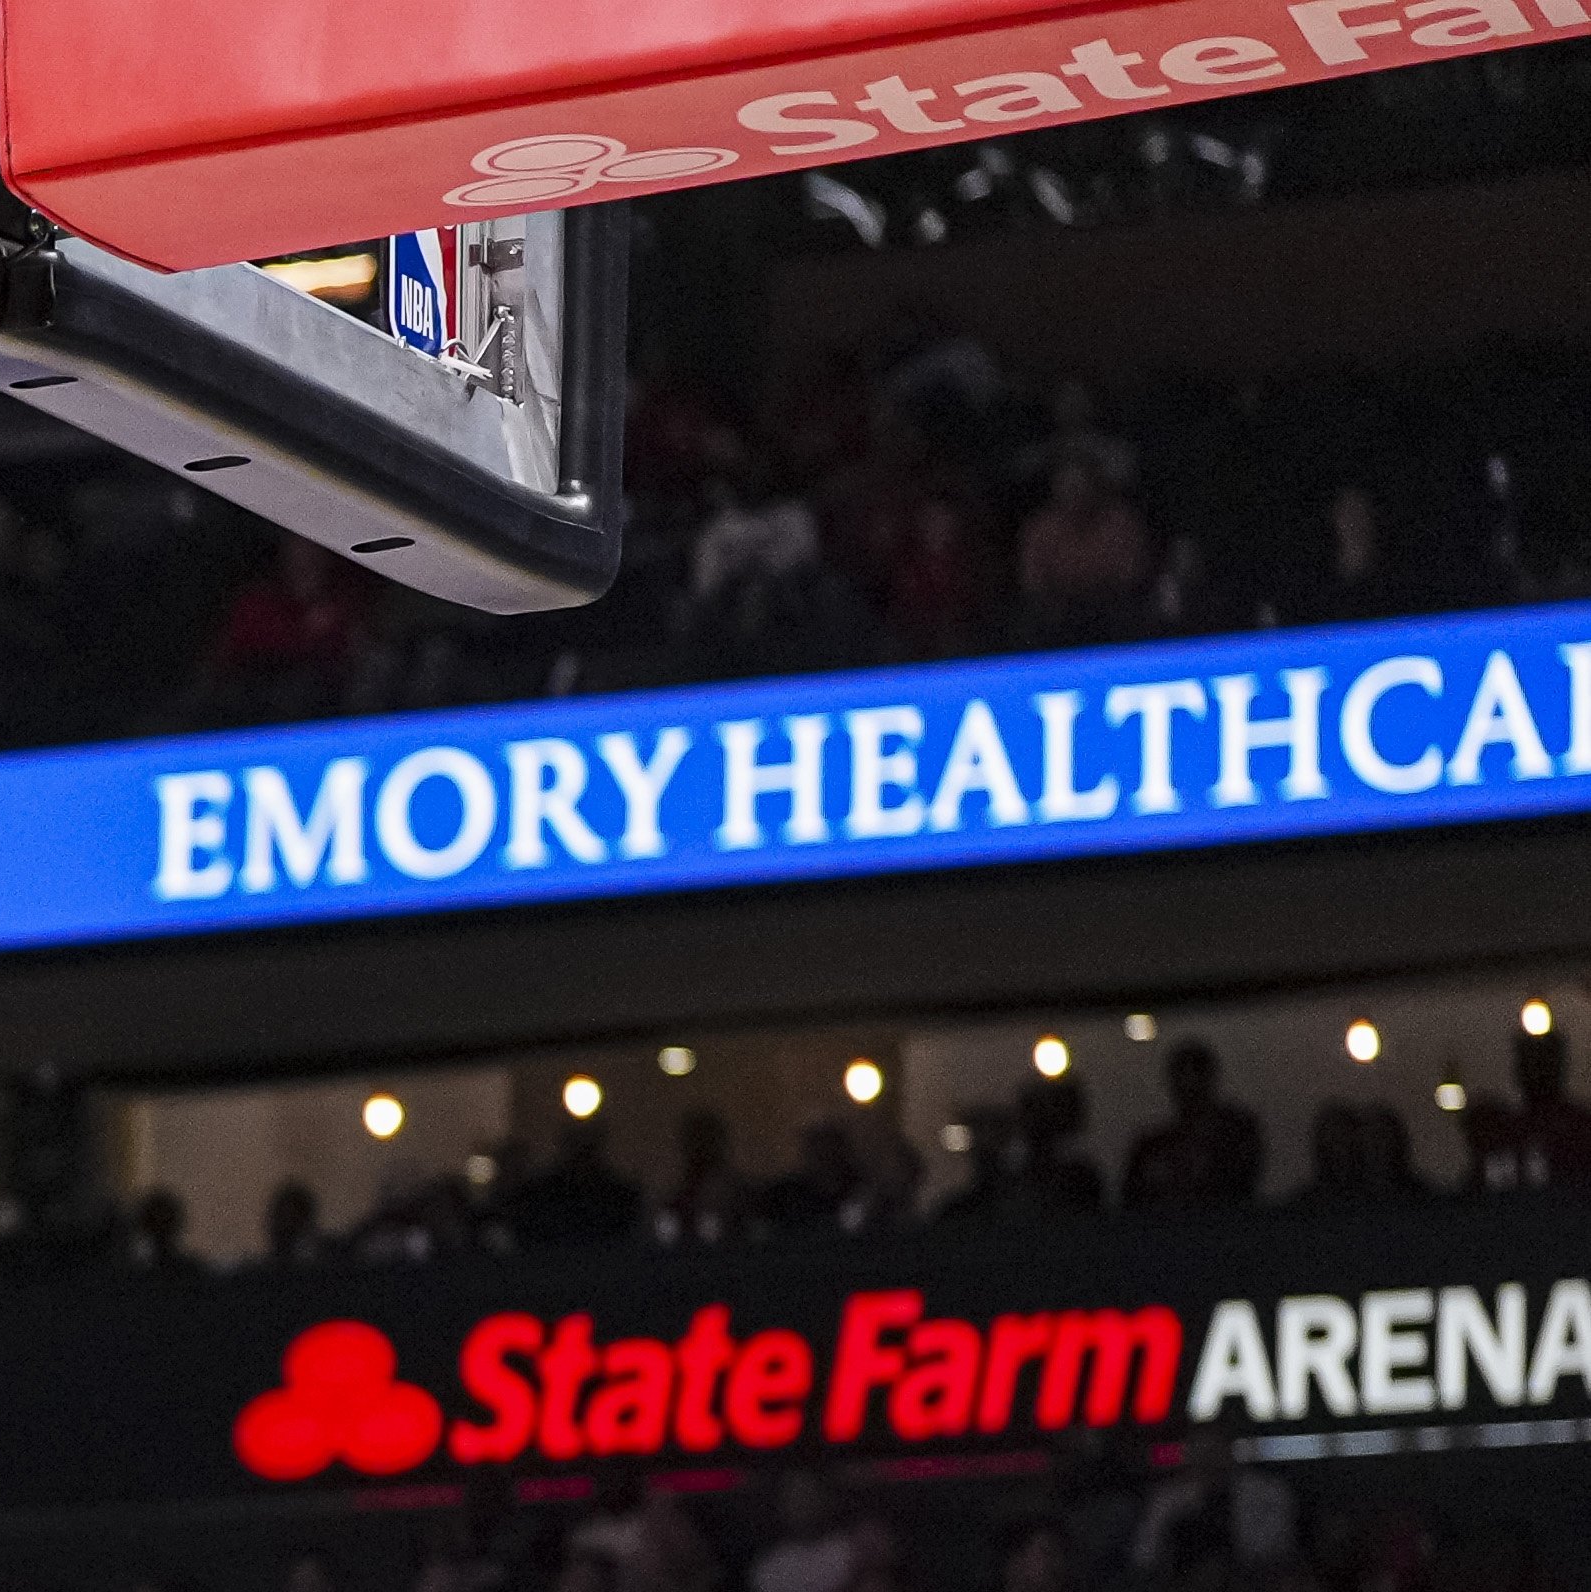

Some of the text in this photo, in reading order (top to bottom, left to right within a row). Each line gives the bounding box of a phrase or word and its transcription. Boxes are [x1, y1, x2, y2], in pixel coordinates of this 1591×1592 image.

[736, 34, 1287, 155] State
[400, 273, 434, 341] NBA
[152, 724, 692, 903] EMORY
[449, 1277, 1591, 1466] State Farm ARENA
